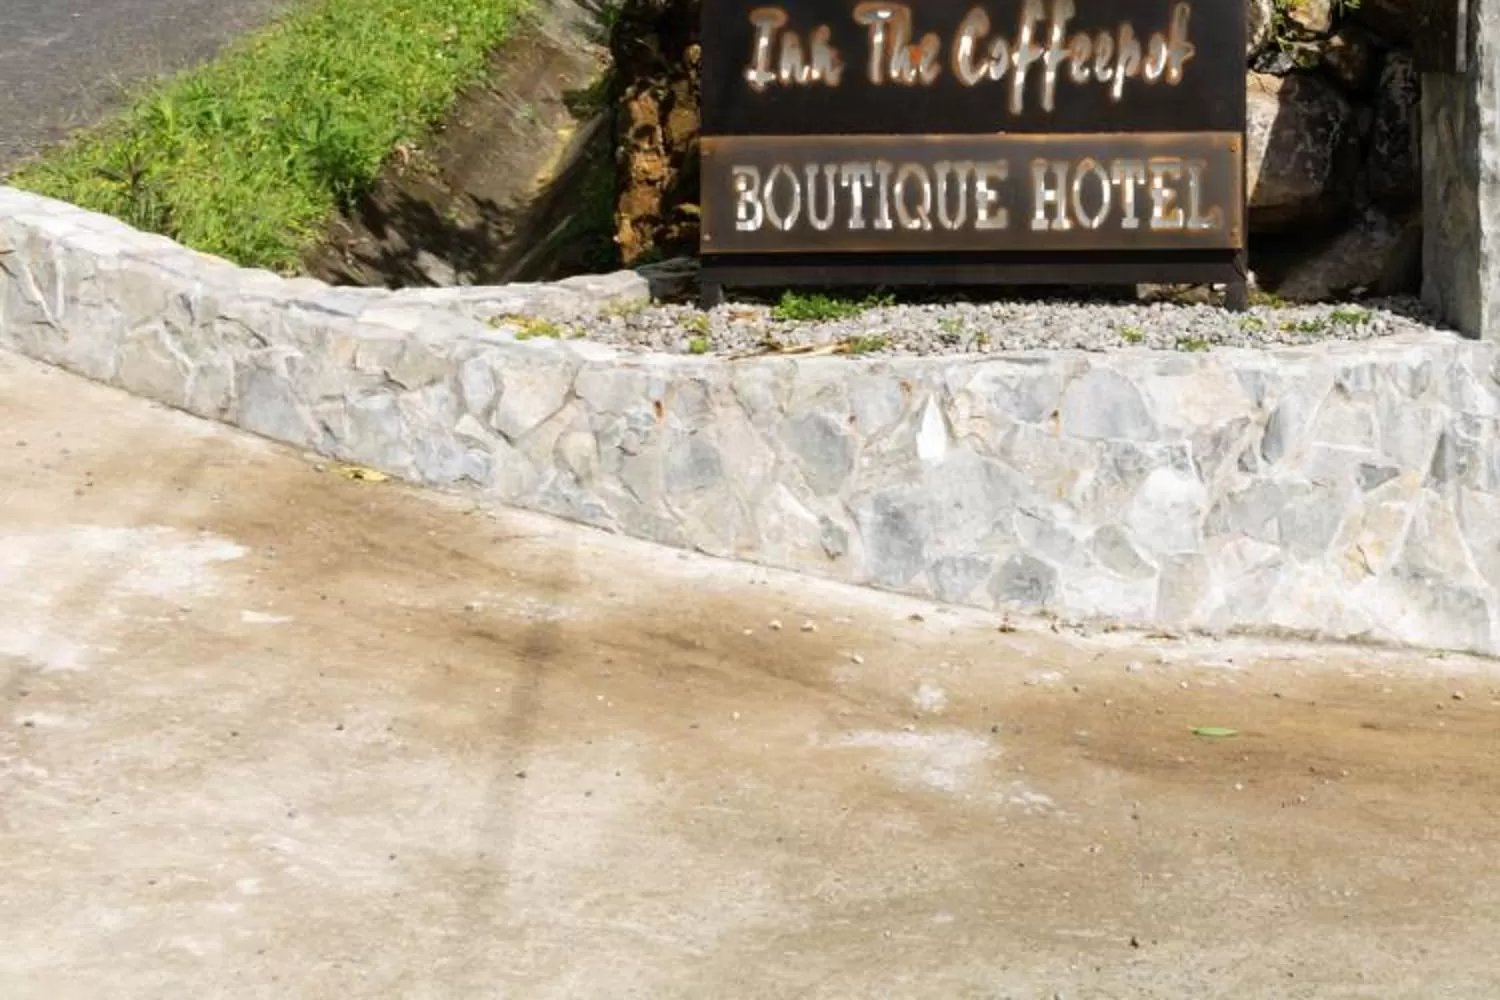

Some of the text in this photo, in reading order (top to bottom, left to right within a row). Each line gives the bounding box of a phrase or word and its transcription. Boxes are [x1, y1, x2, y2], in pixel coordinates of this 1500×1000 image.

[745, 6, 843, 90] Inn
[853, 0, 941, 85] The
[732, 157, 1222, 232] BOUTIQUE HOTEL
